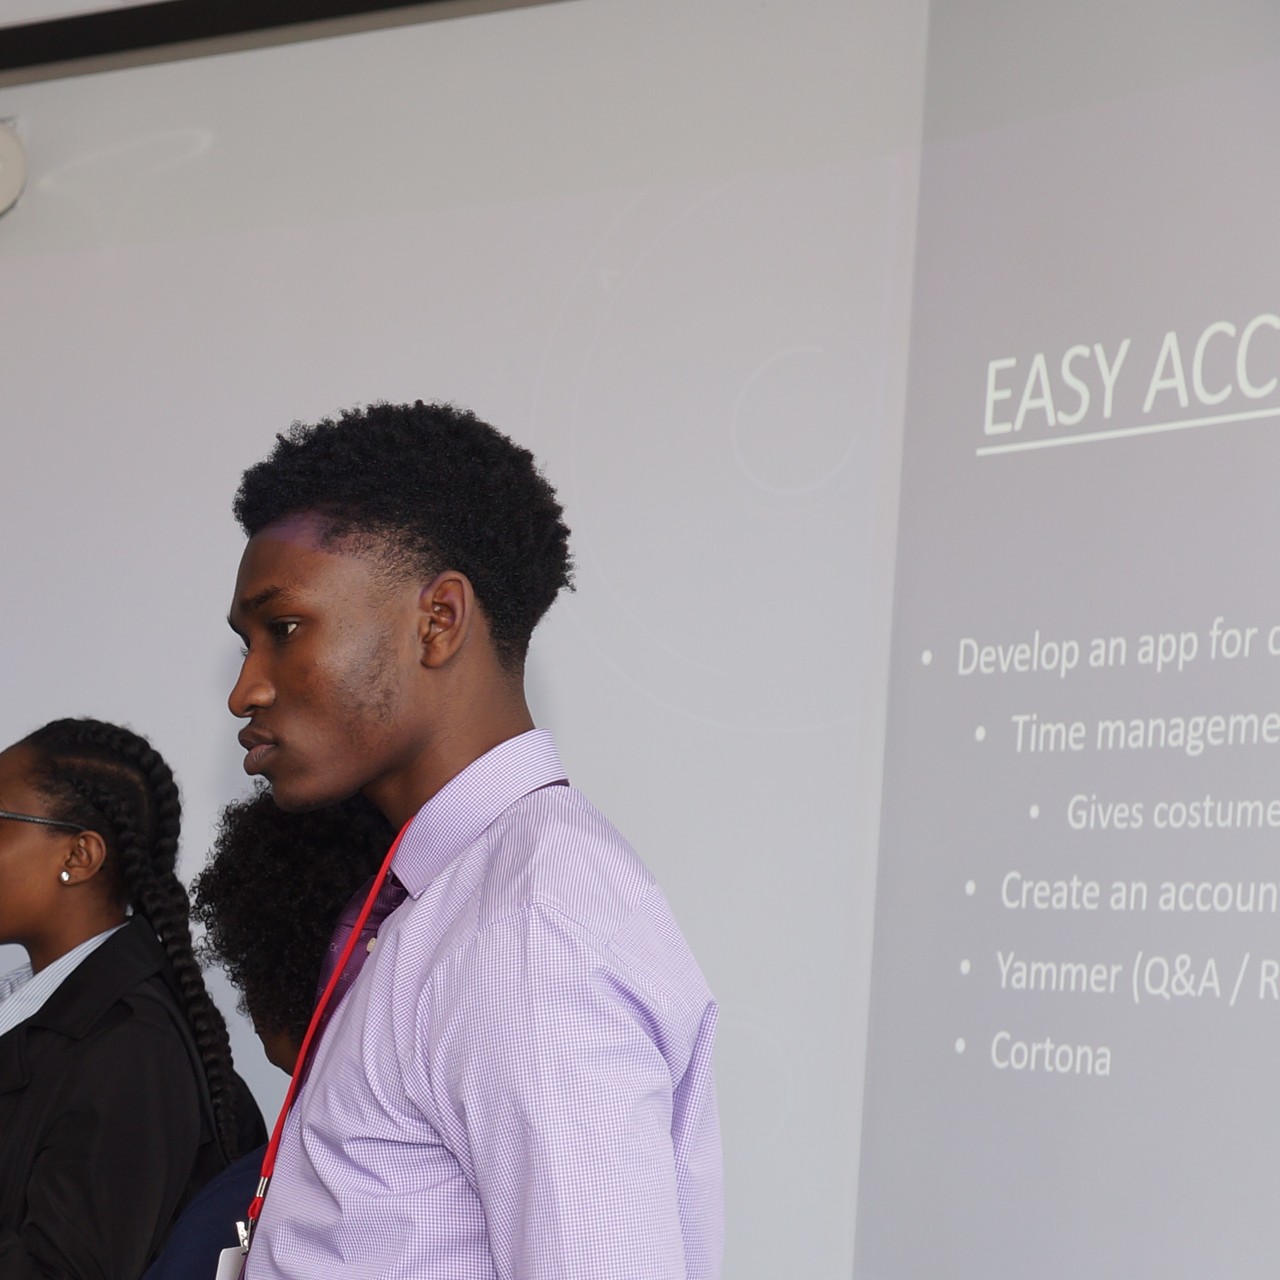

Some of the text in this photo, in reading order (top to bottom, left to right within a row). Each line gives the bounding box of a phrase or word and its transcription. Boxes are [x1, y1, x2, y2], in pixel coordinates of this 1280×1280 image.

[983, 313, 1280, 437] EASY ACC
[957, 630, 1080, 679] Develop
[1088, 636, 1127, 668] an
[1137, 631, 1199, 673] app
[1209, 616, 1259, 660] for
[1011, 713, 1086, 753] Time
[1067, 793, 1144, 830] Gives
[1001, 870, 1280, 913] Create an accoun
[996, 951, 1123, 994] Yammer
[1132, 950, 1221, 1004] (Q&A
[1229, 952, 1251, 1007] /
[991, 1030, 1112, 1076] Cortona
